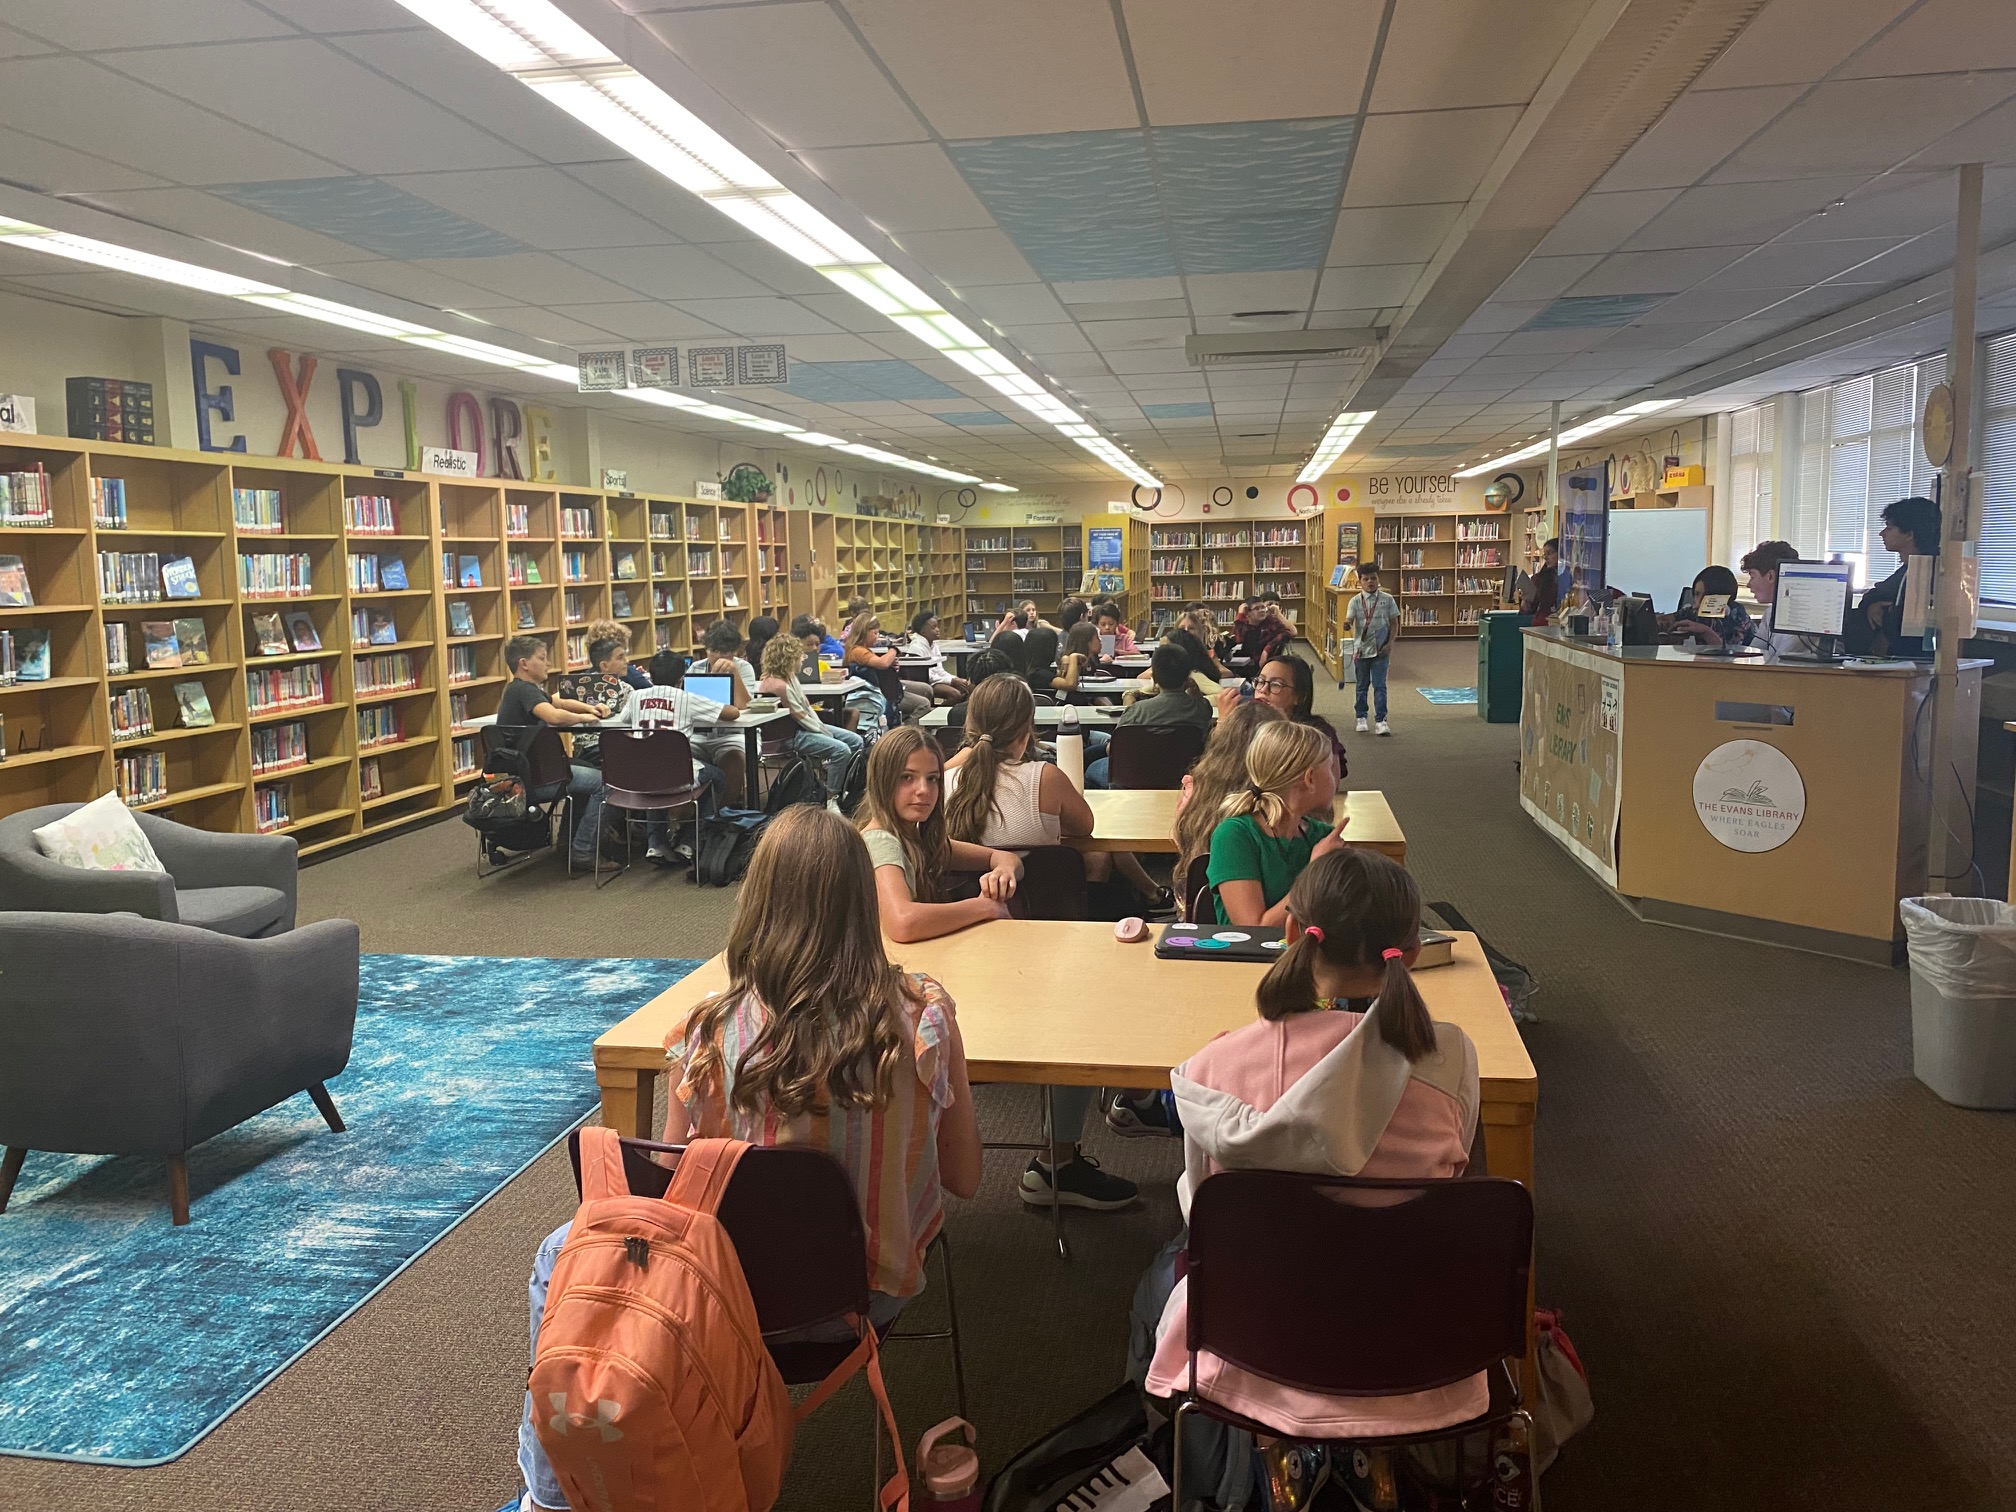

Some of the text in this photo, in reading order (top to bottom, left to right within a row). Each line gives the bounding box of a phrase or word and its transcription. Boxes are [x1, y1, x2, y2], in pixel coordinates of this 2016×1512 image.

[190, 339, 556, 484] EXPLORE
[433, 454, 466, 470] Realistic
[604, 472, 625, 486] Sports
[701, 485, 716, 496] Science
[1371, 498, 1395, 509] everyone
[1414, 494, 1435, 508] already
[1436, 495, 1452, 504] taken
[640, 698, 674, 713] VESTAL
[1698, 802, 1800, 821] THE EVANS LIBRARY
[1710, 815, 1785, 831] WHERE EAGLES
[1734, 828, 1760, 838] SOAR
